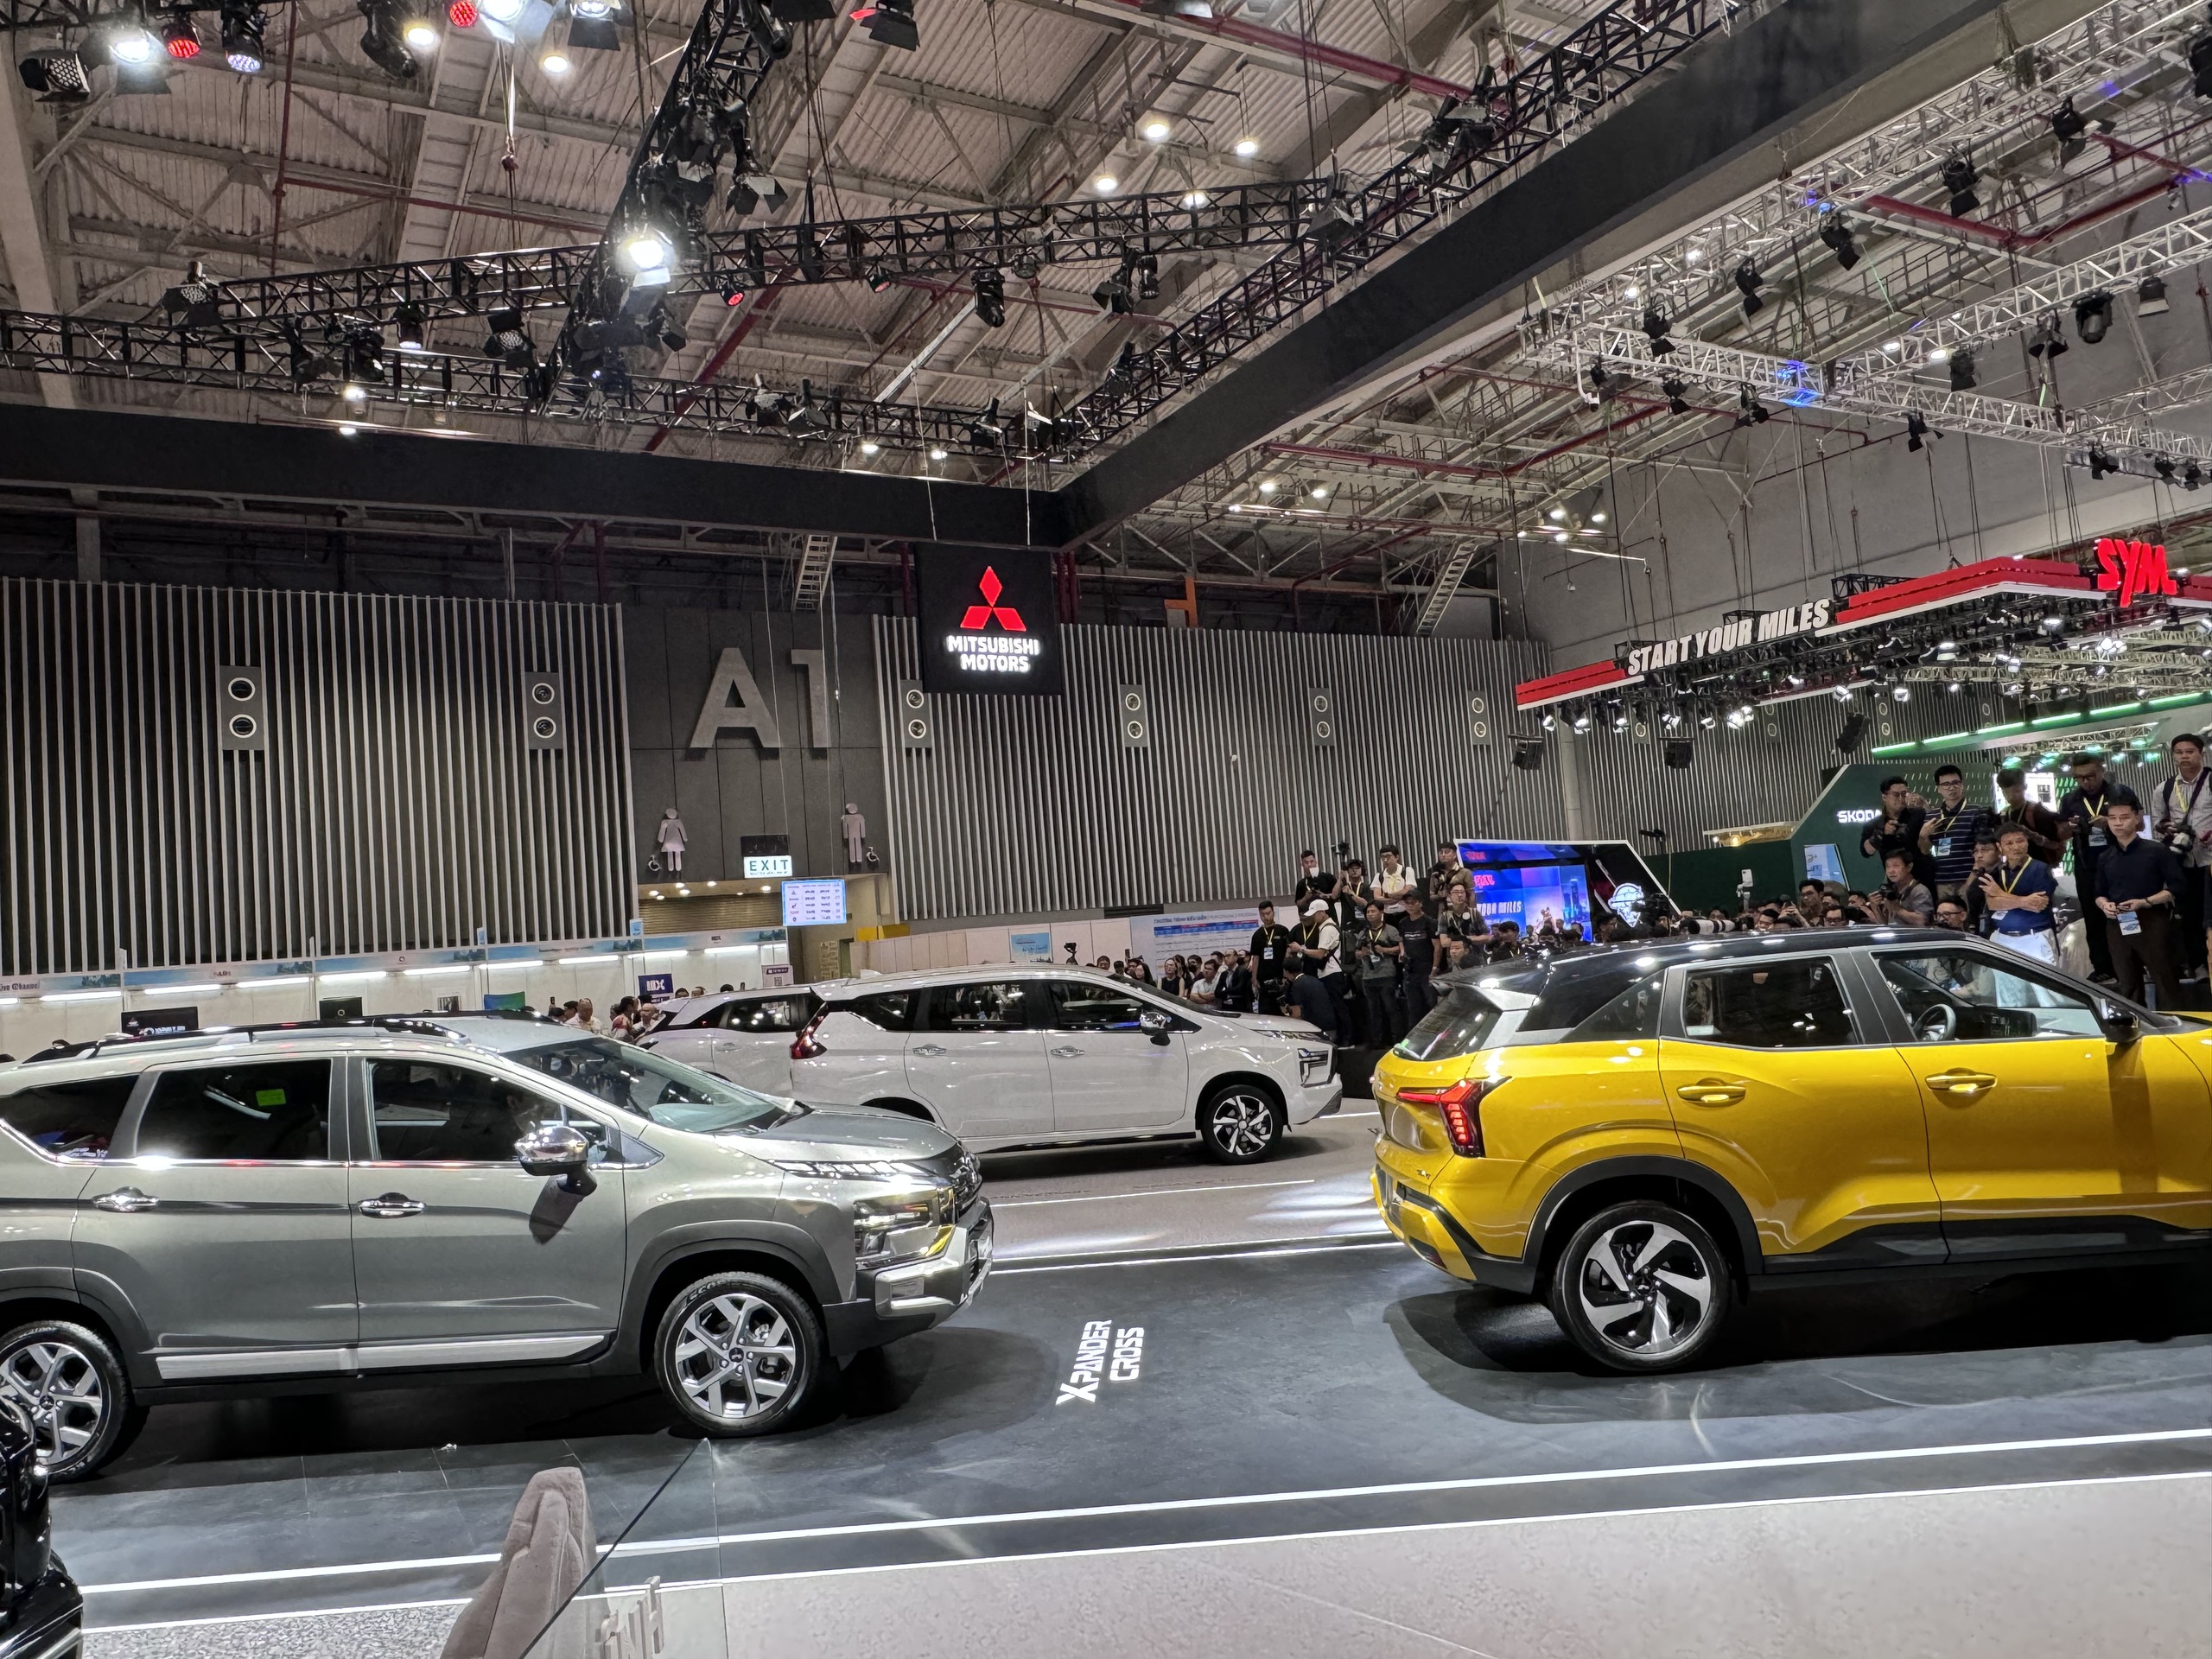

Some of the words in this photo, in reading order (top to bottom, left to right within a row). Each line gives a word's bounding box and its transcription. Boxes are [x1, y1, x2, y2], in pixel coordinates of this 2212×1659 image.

[2097, 537, 2177, 608] SYM
[946, 635, 1041, 656] MITSUBISHI
[960, 653, 1031, 672] MOTORS
[1627, 635, 1693, 676] START
[1695, 618, 1753, 658] YOUR
[1757, 598, 1830, 642] MILES
[690, 647, 831, 748] A1
[749, 859, 789, 872] EXIT
[1498, 901, 1522, 914] MILES
[1055, 1319, 1112, 1406] XPANDER
[1109, 1326, 1145, 1382] CROSS
